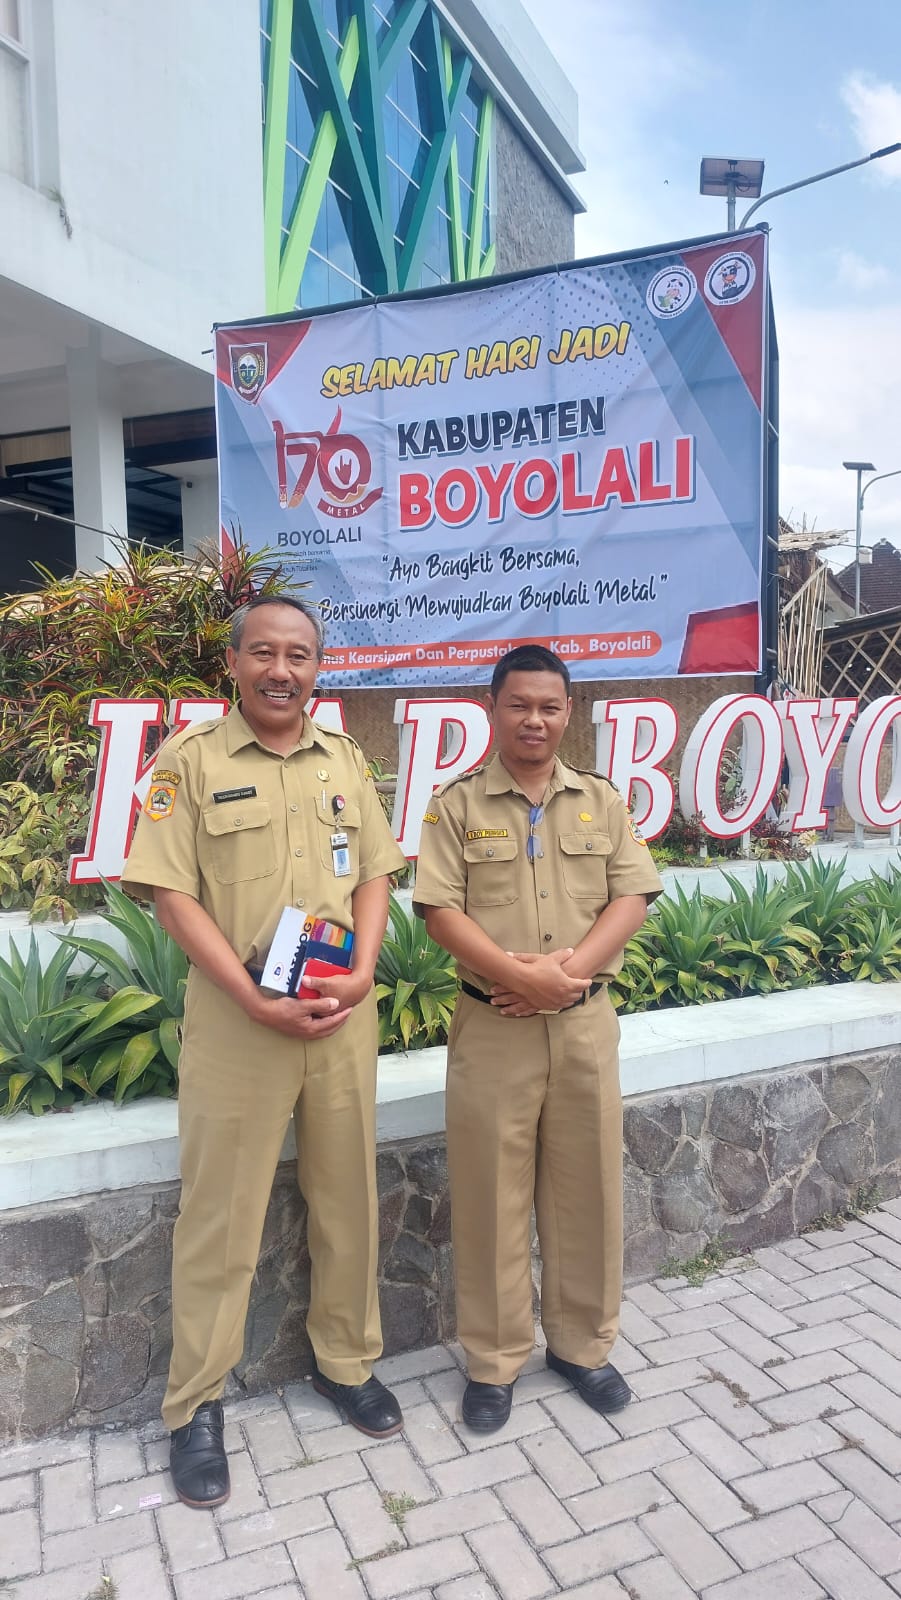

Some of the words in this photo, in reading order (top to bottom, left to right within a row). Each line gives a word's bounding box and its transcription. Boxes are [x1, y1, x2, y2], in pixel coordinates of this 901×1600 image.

[321, 349, 458, 398] SELAMAT
[465, 335, 541, 379] HARI
[548, 321, 631, 364] JADI
[398, 397, 606, 459] KABUPATEN
[400, 435, 694, 530] BOYOLALI
[326, 504, 366, 517] METAL
[277, 527, 362, 547] BOYOLALI
[426, 551, 494, 580] Bangkit
[500, 547, 580, 573] Bersama,
[318, 598, 401, 623] Bersinergi
[405, 591, 512, 621] Mewujudkan
[518, 580, 590, 613] Boyolali
[349, 651, 411, 664] Kearsipan
[416, 648, 444, 660] Dan
[550, 640, 584, 654] Kab.
[590, 636, 651, 655] Boyolali
